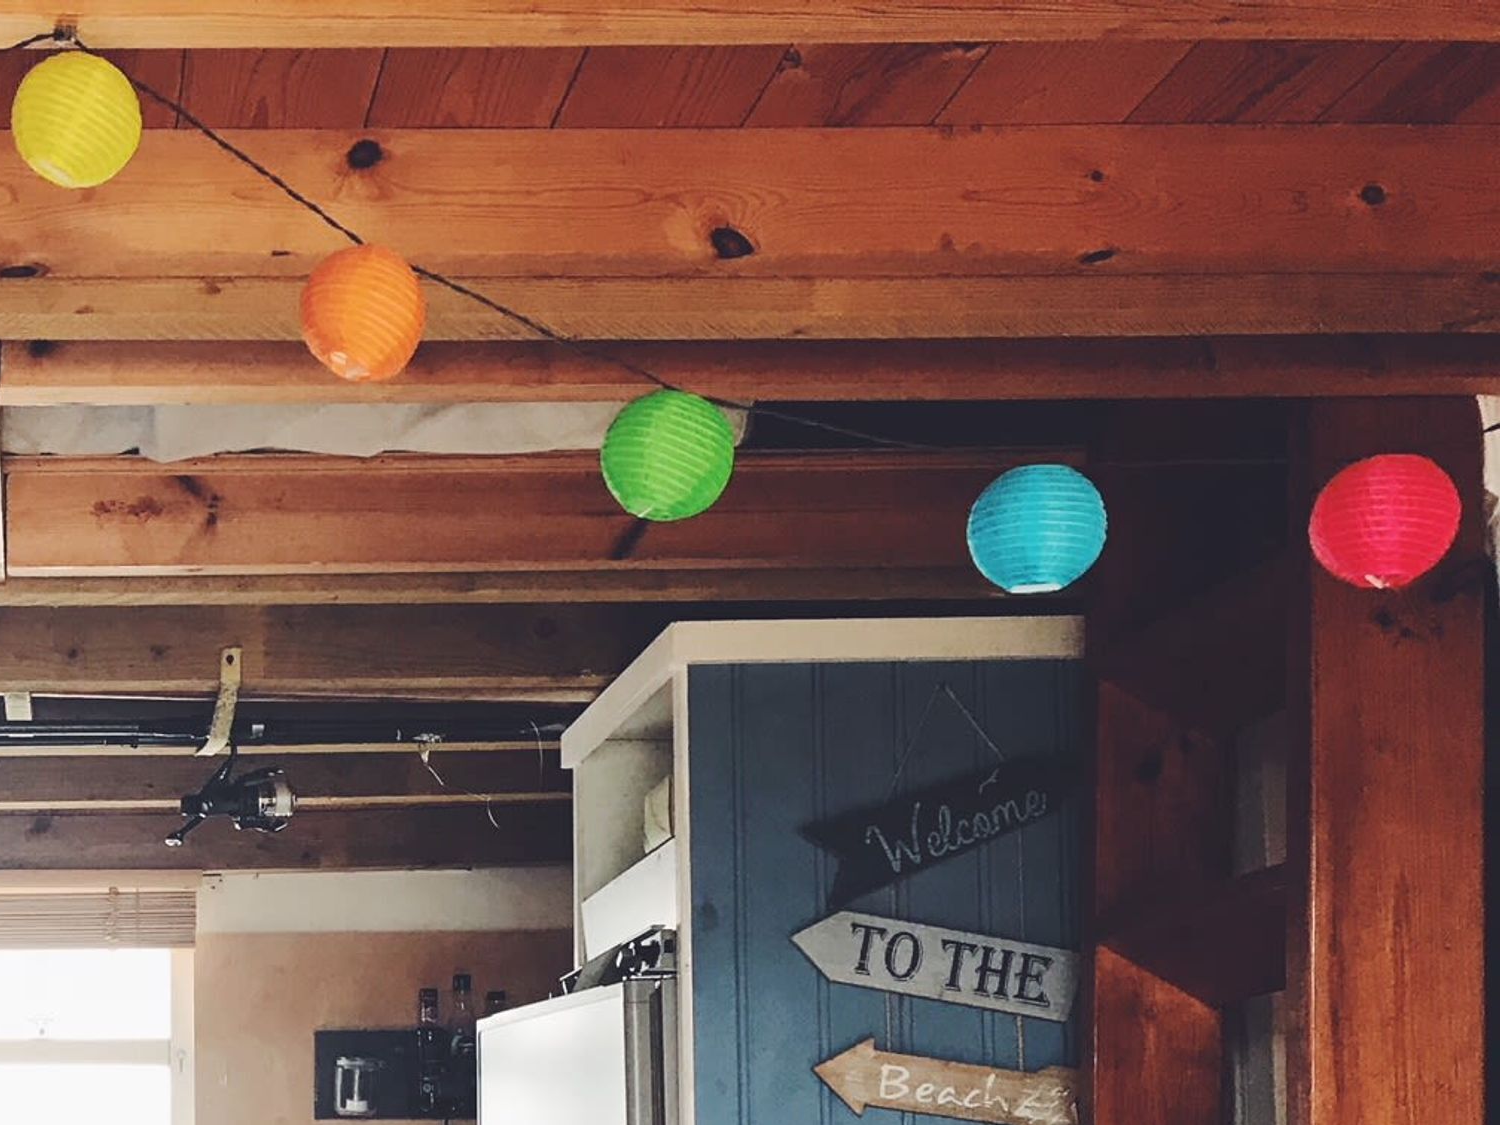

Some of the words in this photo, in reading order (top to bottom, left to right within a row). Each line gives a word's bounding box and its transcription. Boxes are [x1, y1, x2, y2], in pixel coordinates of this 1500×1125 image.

[865, 790, 1047, 872] Welcome
[851, 923, 922, 981] TO
[941, 939, 1053, 1006] THE
[879, 1065, 1008, 1111] Beach
